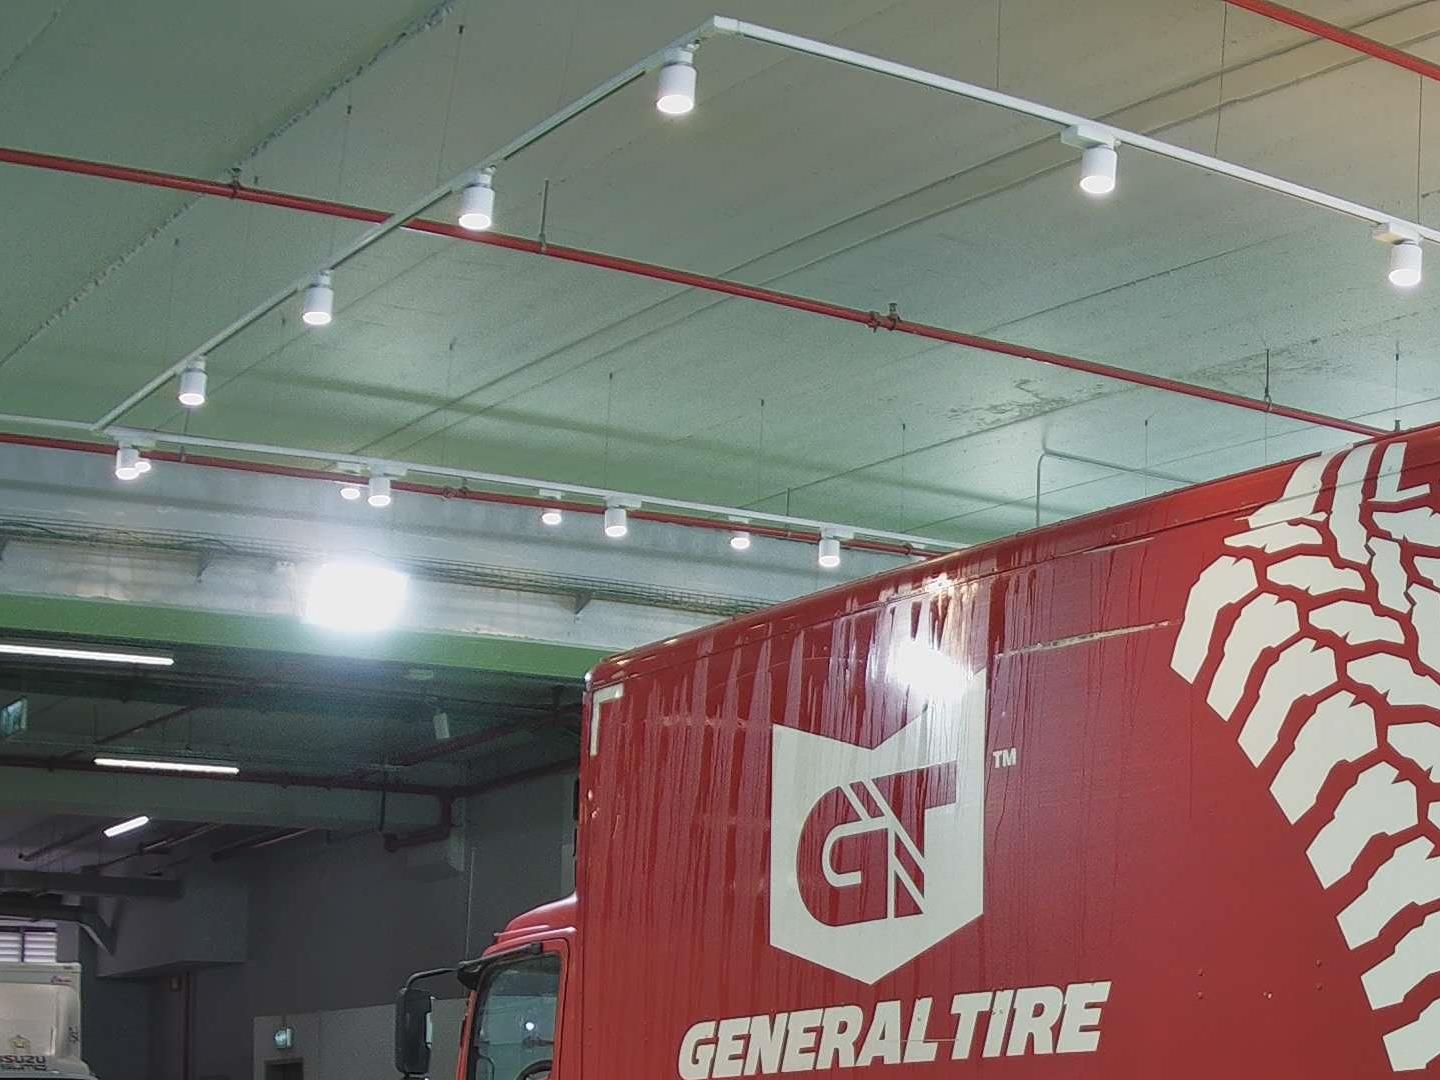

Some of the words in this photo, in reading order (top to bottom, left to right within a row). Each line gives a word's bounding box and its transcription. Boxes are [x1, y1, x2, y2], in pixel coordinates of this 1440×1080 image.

[992, 748, 1017, 768] TM
[677, 997, 938, 1080] GENERAL
[949, 981, 1112, 1060] TIRE
